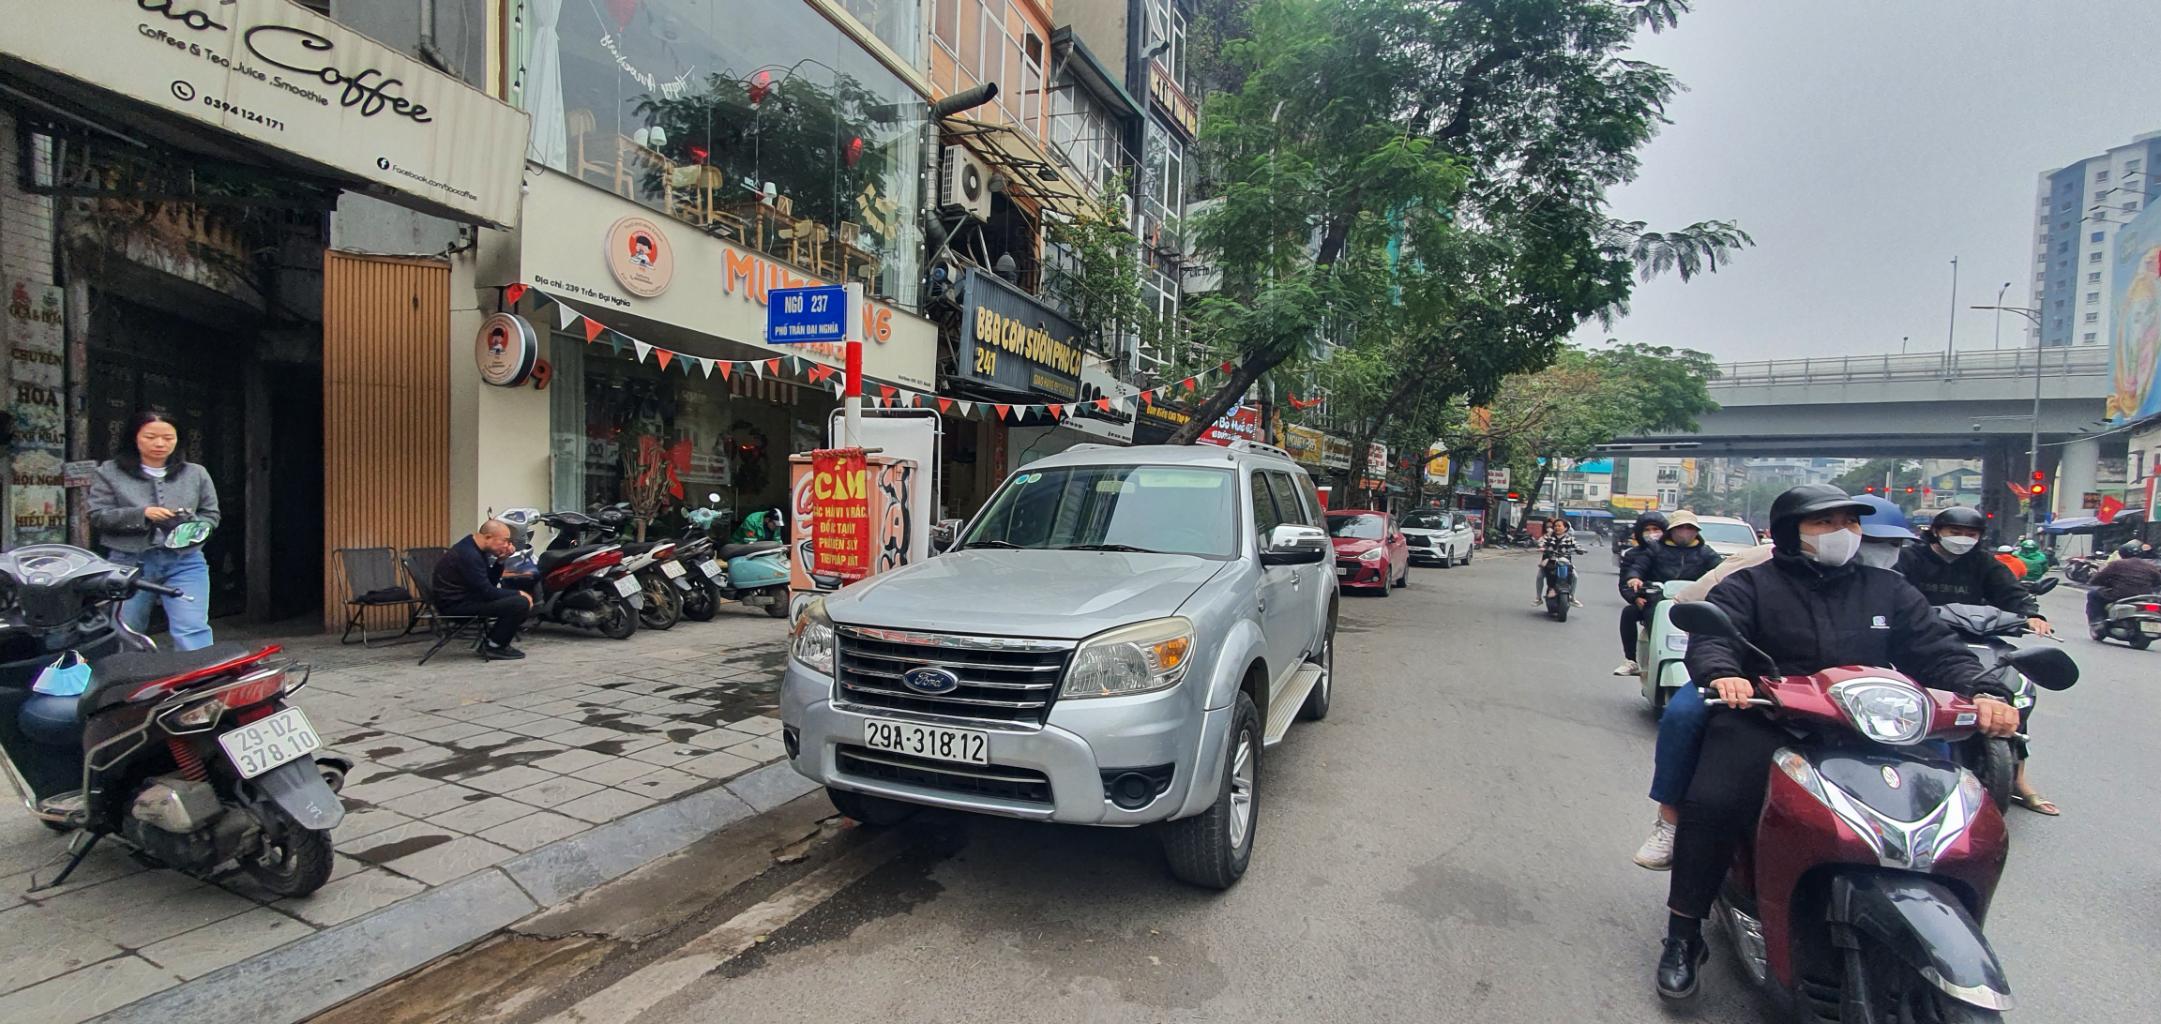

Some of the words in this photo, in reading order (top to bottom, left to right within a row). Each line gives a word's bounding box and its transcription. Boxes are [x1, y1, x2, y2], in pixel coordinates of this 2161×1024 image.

[138, 23, 187, 50] Coffee
[189, 43, 201, 57] &
[204, 48, 230, 68] Tea
[232, 62, 267, 82] Juice
[244, 25, 432, 123] Coffee
[204, 96, 239, 115] 0394
[565, 283, 579, 293] 239
[810, 295, 828, 313] 237
[774, 322, 788, 337] PHỐ
[976, 347, 997, 377] 241
[814, 458, 867, 500] CẤM
[914, 672, 943, 688] Ford
[240, 730, 315, 773] 378.10
